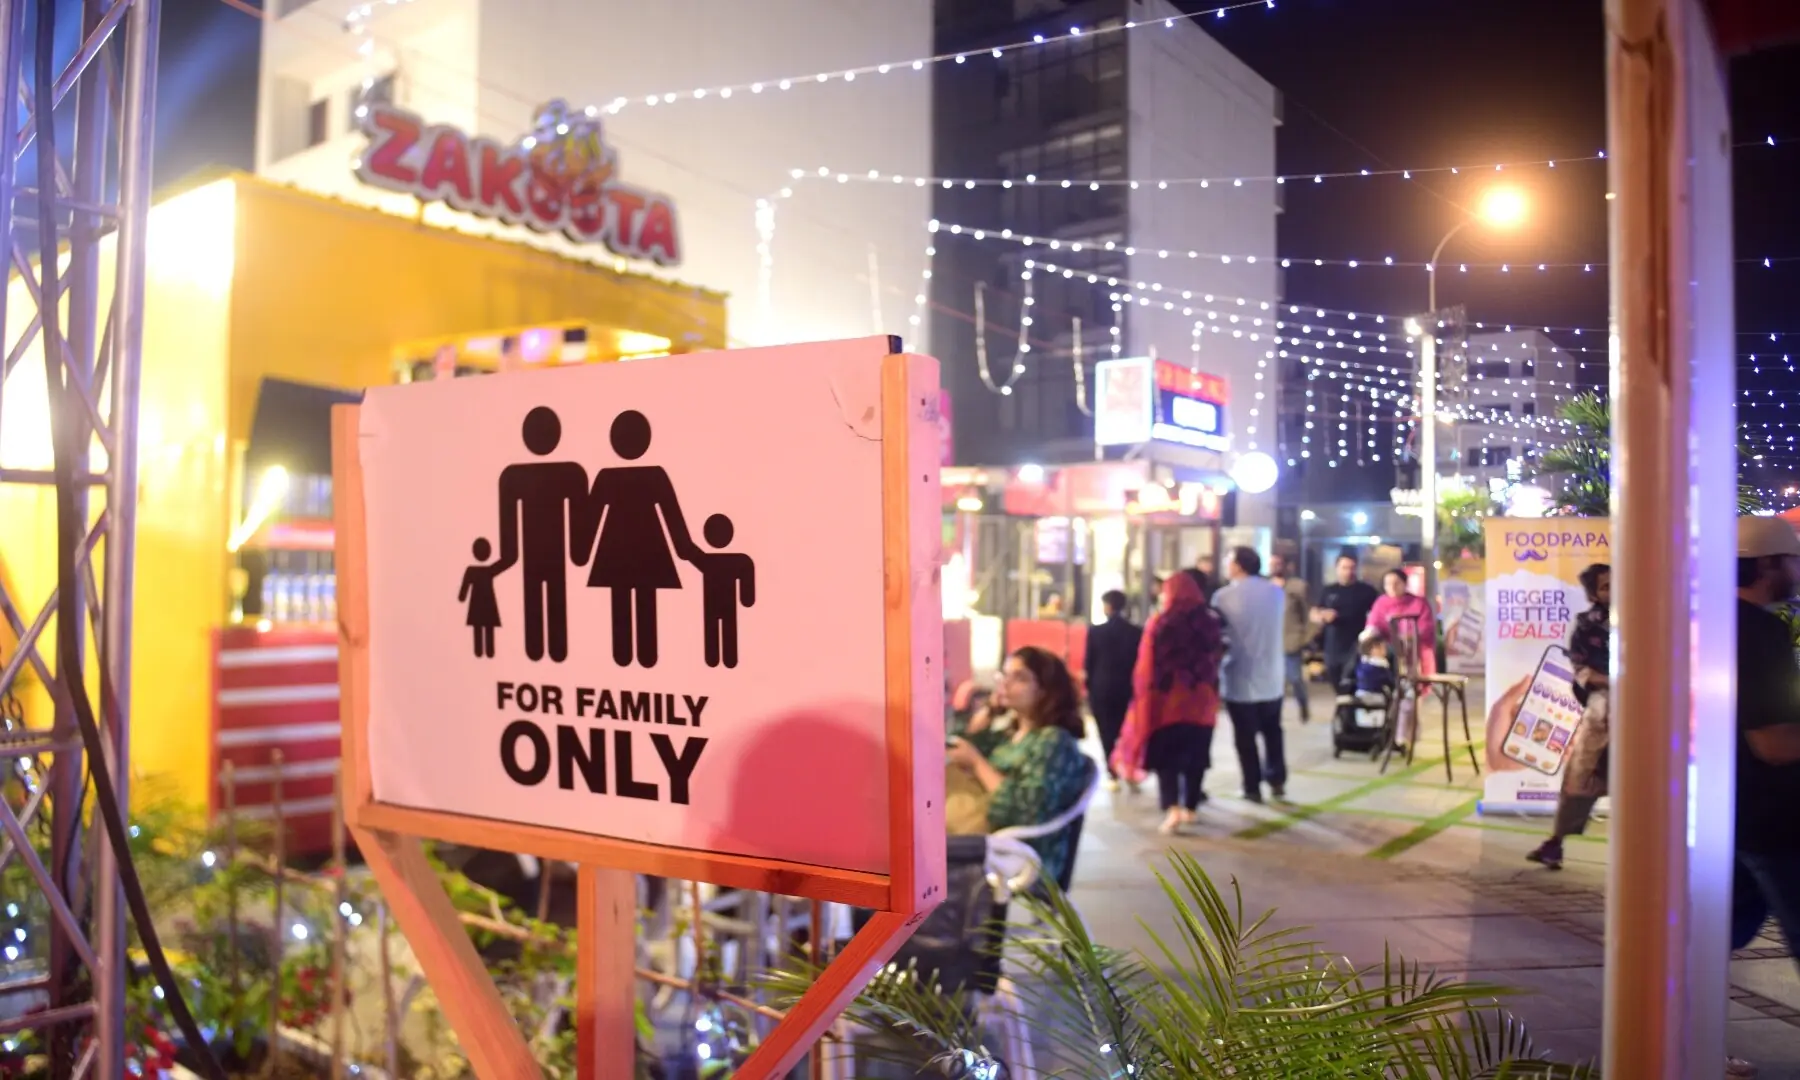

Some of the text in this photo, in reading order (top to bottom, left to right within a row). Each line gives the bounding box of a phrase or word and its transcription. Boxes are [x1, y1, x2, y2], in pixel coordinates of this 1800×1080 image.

[364, 108, 681, 263] ZAKOOTA
[1505, 532, 1609, 547] FOODPAPA
[1498, 589, 1565, 605] BIGGER
[1498, 607, 1570, 622] BETTER
[1498, 623, 1566, 639] DEALS!
[497, 681, 709, 727] FOR FAMILY
[500, 719, 709, 805] ONLY
